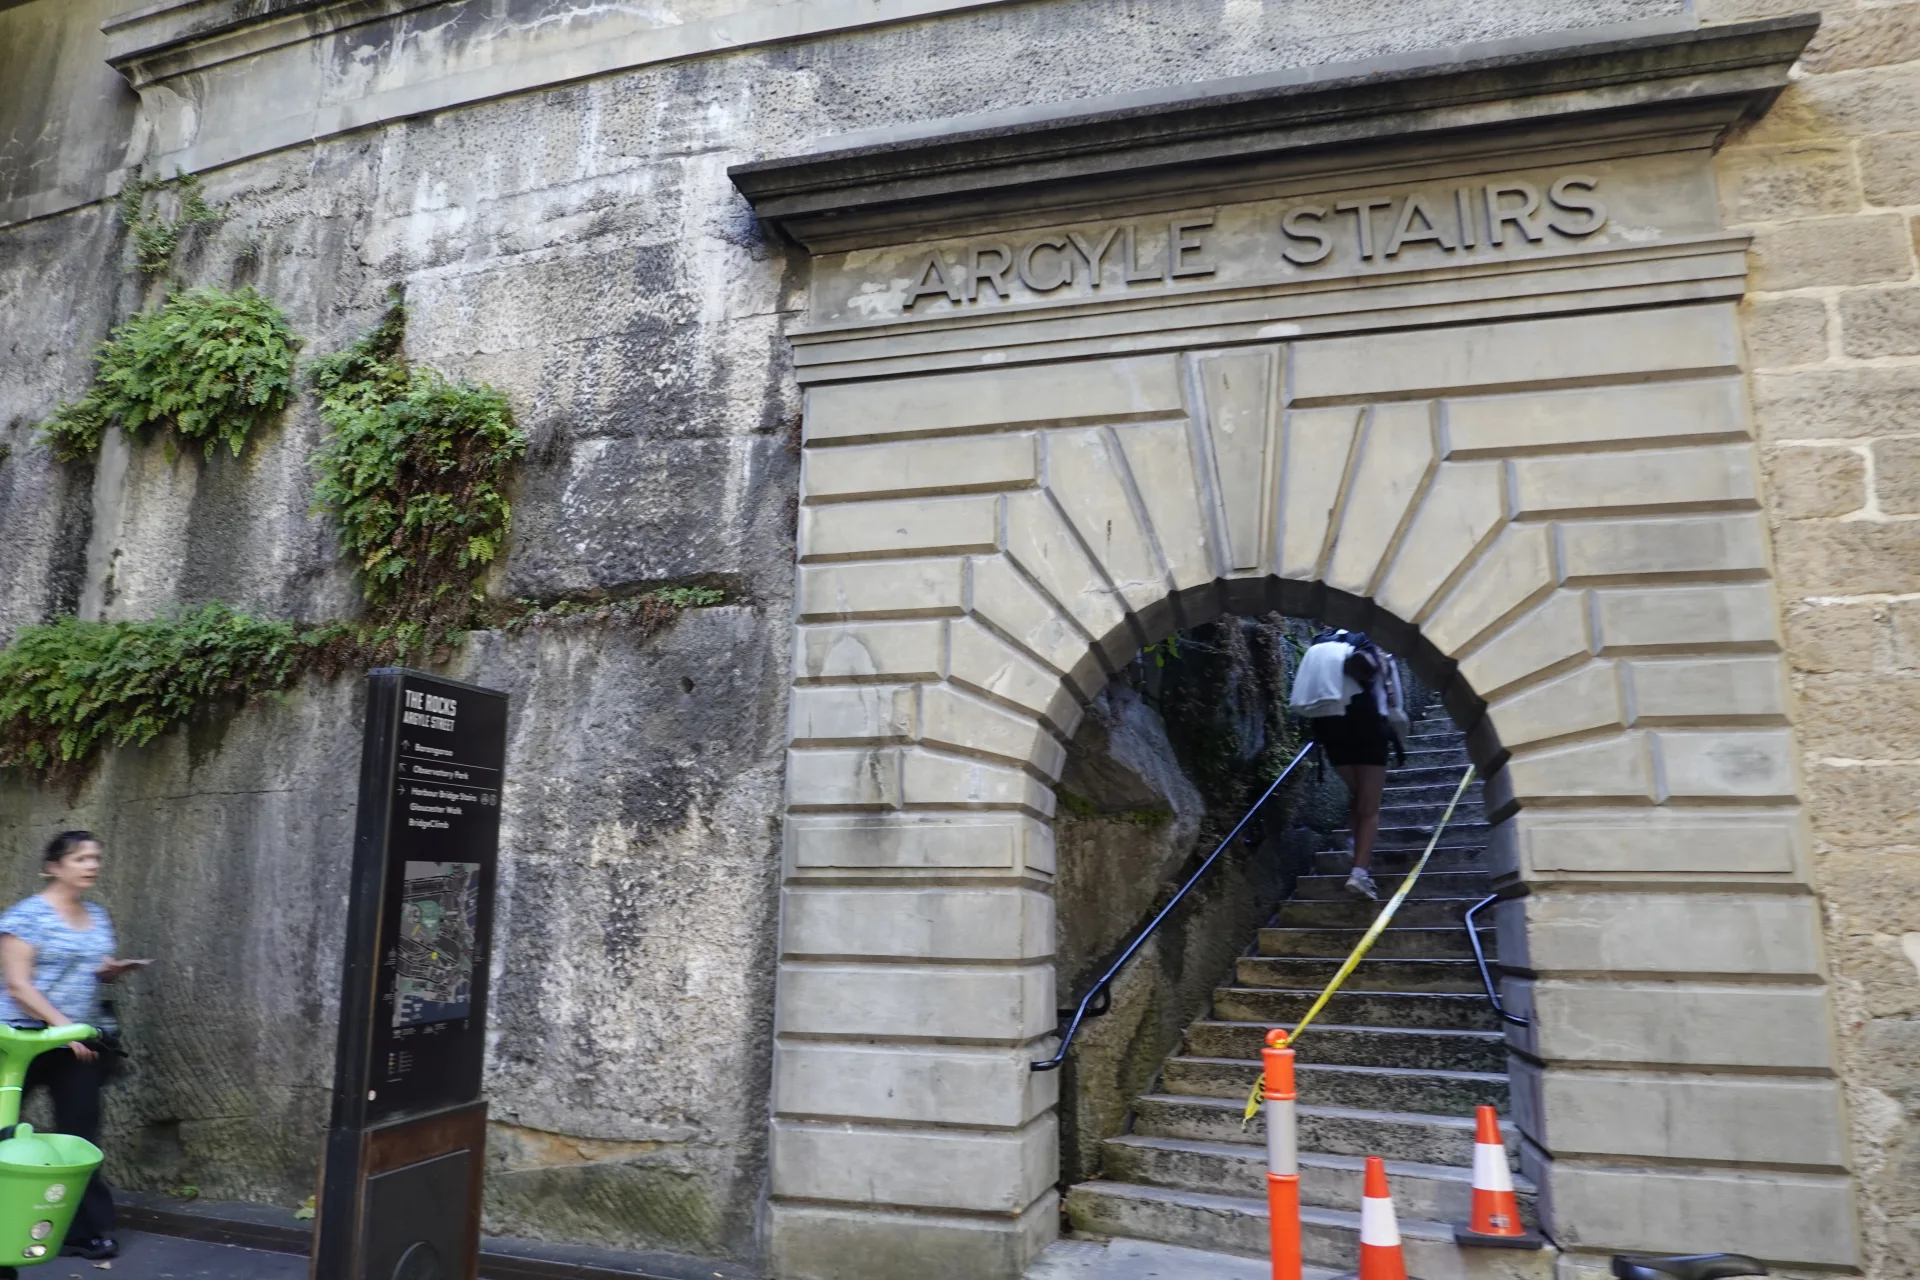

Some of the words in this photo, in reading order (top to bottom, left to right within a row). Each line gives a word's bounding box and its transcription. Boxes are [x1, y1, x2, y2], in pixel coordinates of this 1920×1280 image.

[902, 216, 1217, 309] ARGYLE
[1281, 173, 1606, 268] STAIRS
[405, 689, 424, 710] THE
[425, 693, 457, 717] ROCKS
[402, 710, 430, 728] ARGYLE
[430, 715, 455, 732] STREET
